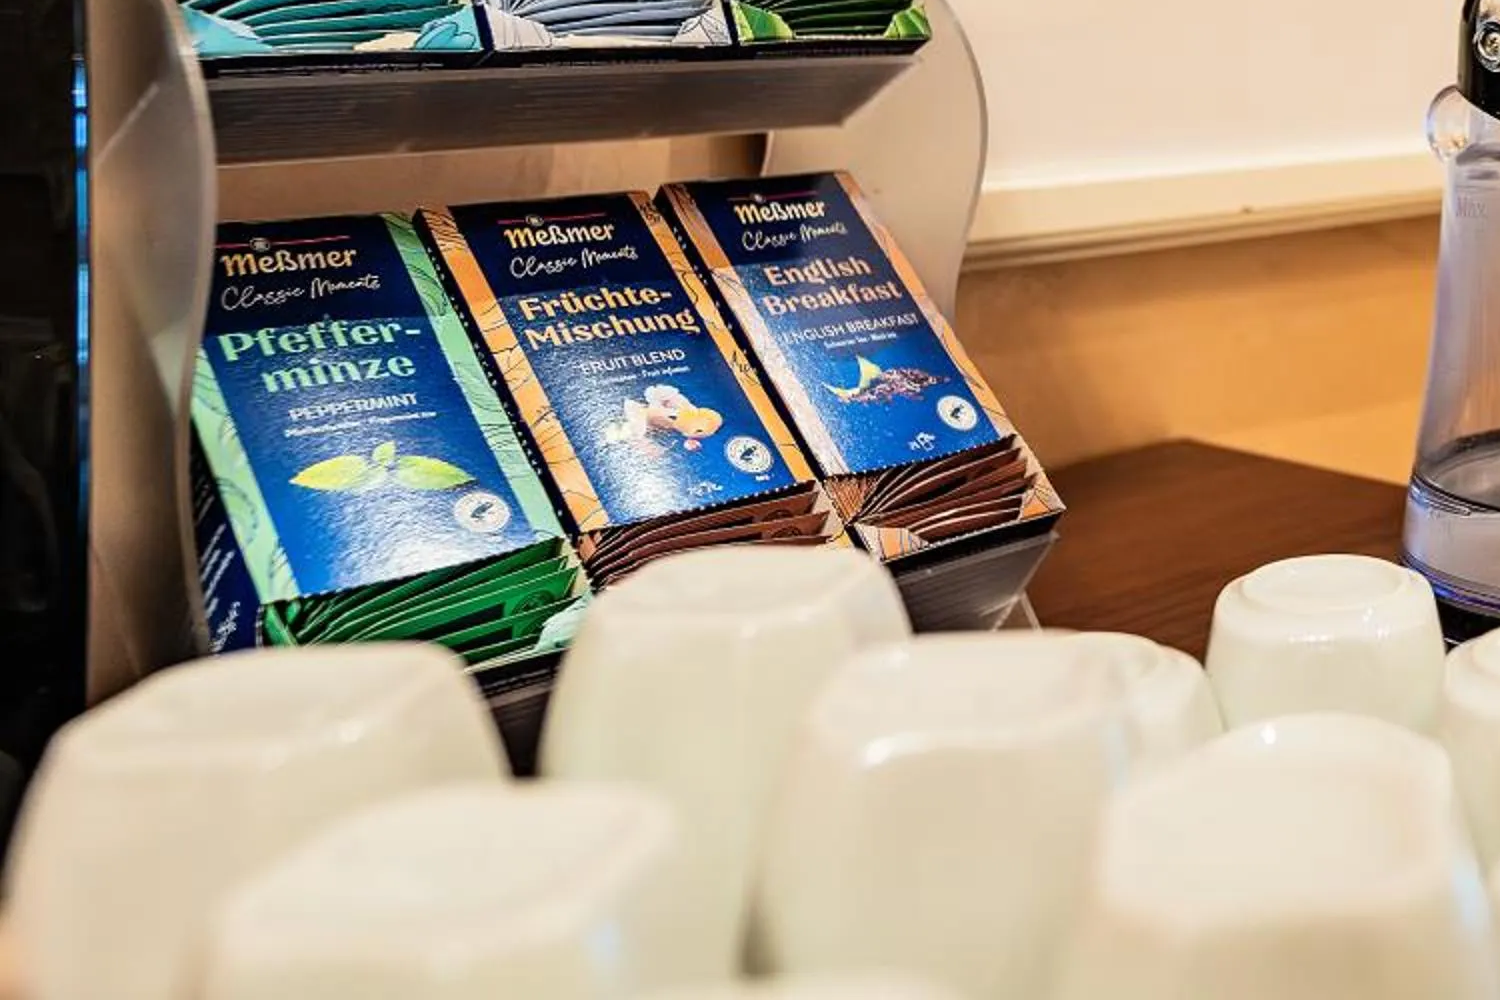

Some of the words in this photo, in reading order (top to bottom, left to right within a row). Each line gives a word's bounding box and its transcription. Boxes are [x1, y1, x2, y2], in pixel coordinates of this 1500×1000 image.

[733, 201, 825, 225] Meßmer
[504, 223, 615, 249] Meßmer
[221, 250, 357, 277] Meßmer
[509, 255, 578, 279] Classic
[581, 243, 639, 269] Moments
[763, 256, 872, 287] English
[221, 286, 305, 311] Classic
[311, 273, 381, 299] Moments
[518, 287, 672, 321] Früchte-
[762, 281, 903, 317] Breakfast
[524, 307, 701, 351] Mischung
[845, 312, 919, 333] BREAKFAST
[217, 320, 421, 362] Pfeffer-
[261, 355, 417, 393] minze
[580, 357, 627, 375] FRUIT
[630, 348, 685, 367] BLEND
[288, 391, 417, 421] PEPPERMINT
